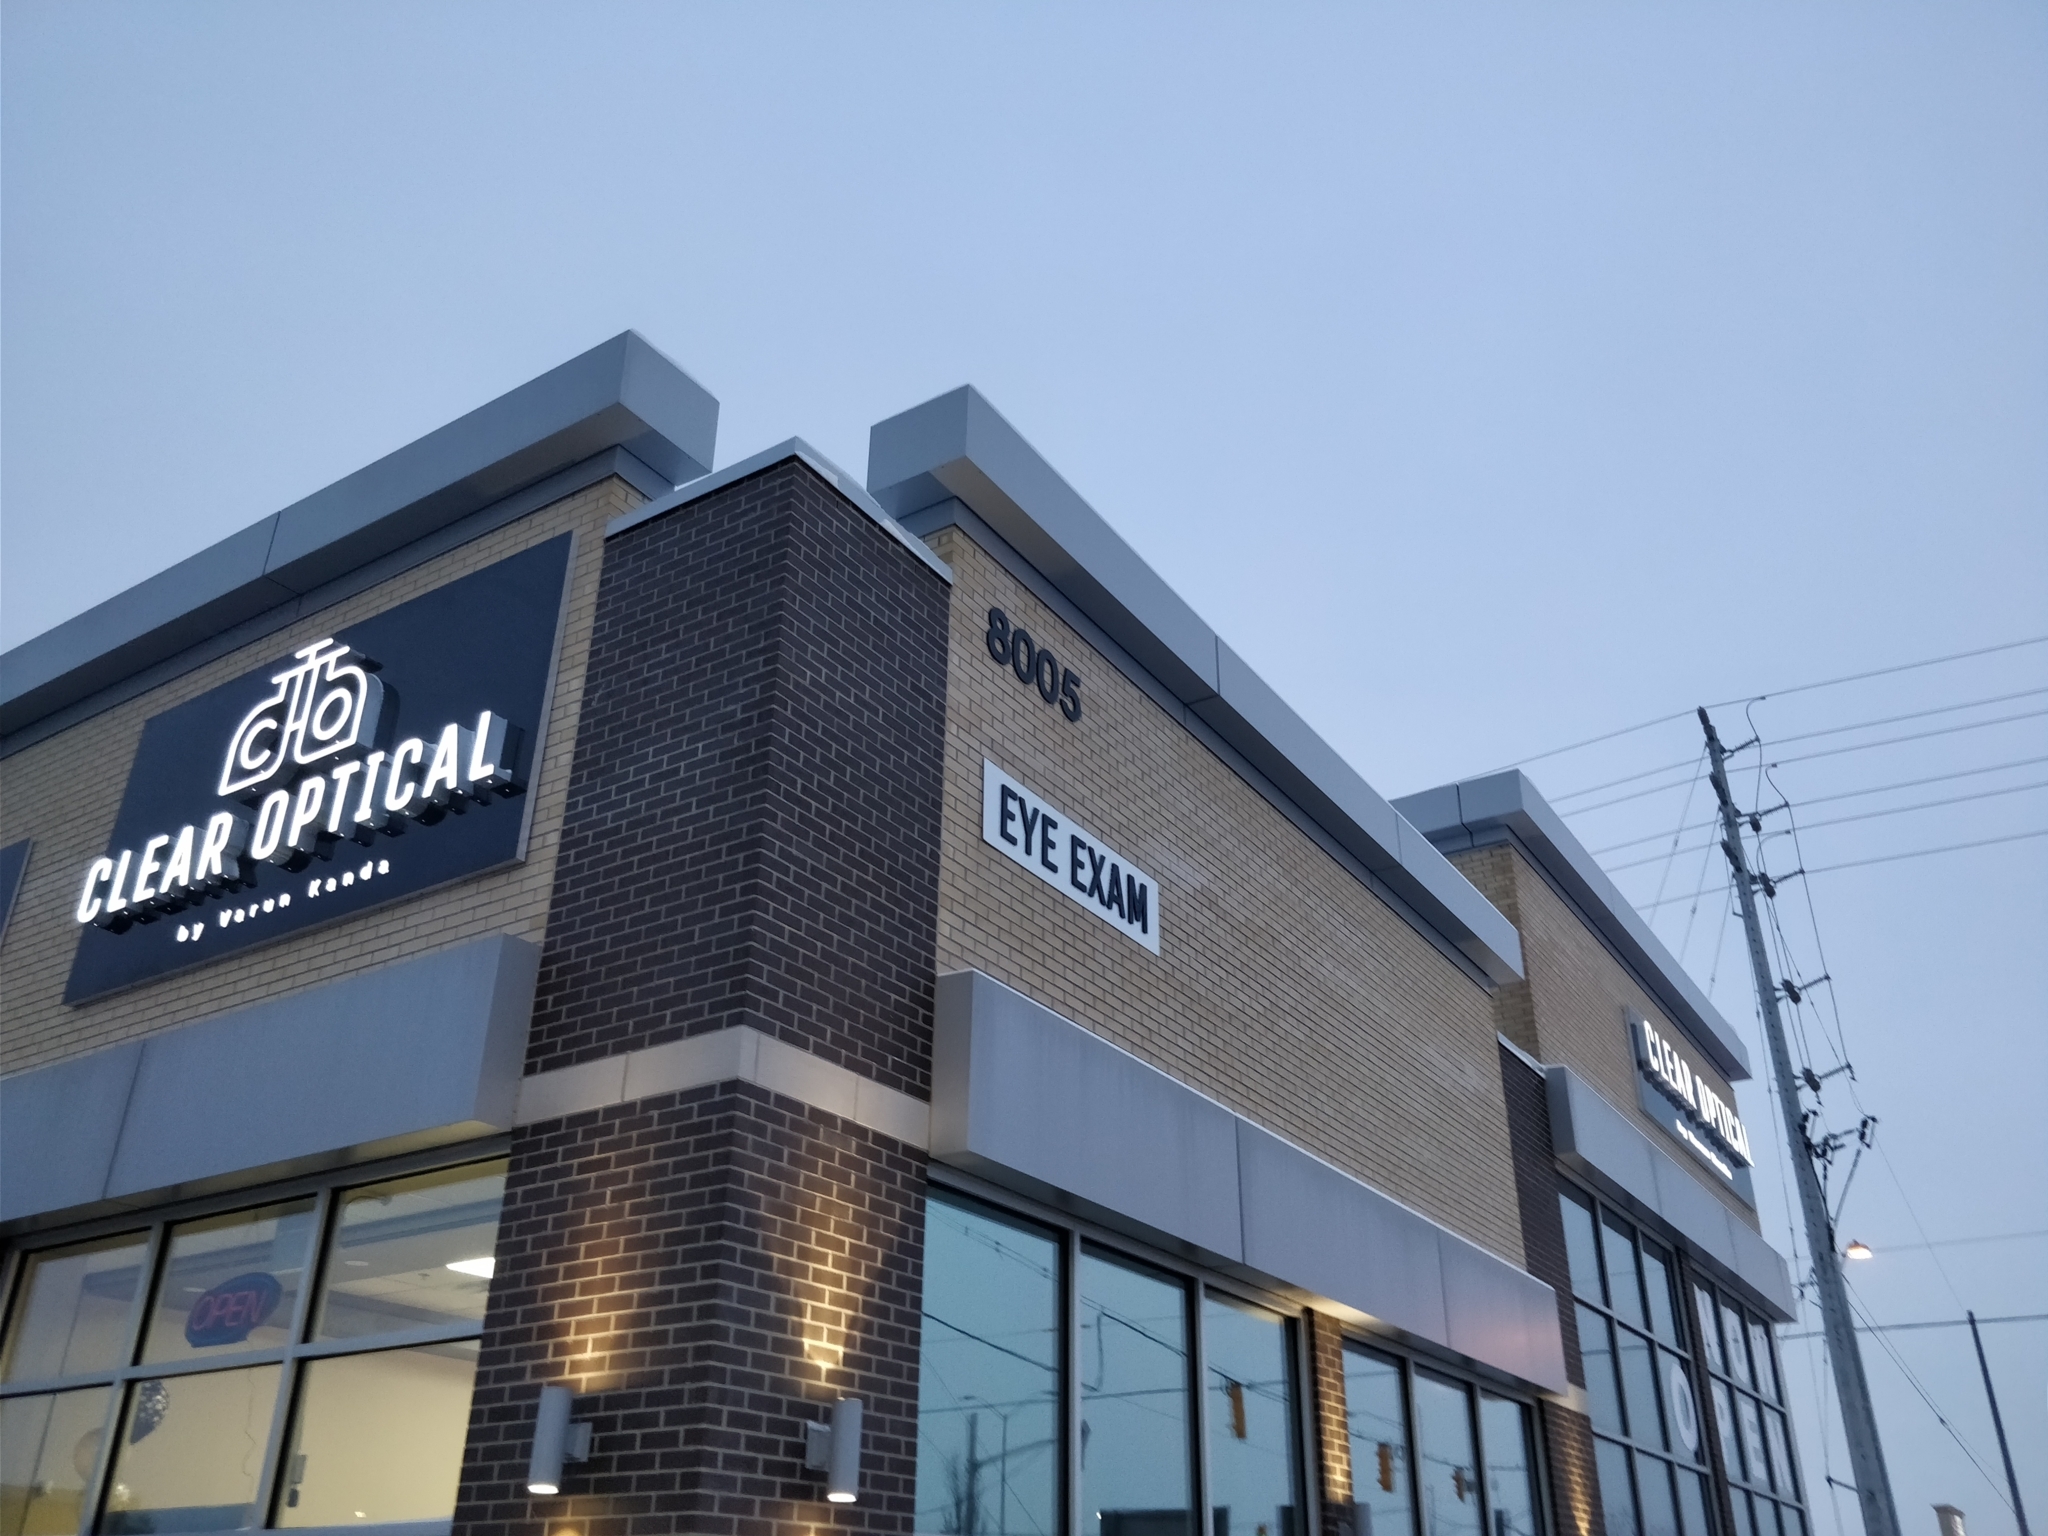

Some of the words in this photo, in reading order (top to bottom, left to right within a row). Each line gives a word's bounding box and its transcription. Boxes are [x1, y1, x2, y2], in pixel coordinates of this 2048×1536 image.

[986, 606, 1082, 723] 8005
[76, 811, 234, 925] CLEAR
[251, 710, 495, 861] OPTICAL
[1000, 783, 1059, 874] EYE
[1070, 834, 1149, 935] EXAM
[176, 922, 205, 943] by
[1643, 1019, 1697, 1110] CLEAR
[192, 1290, 268, 1331] OPEN
